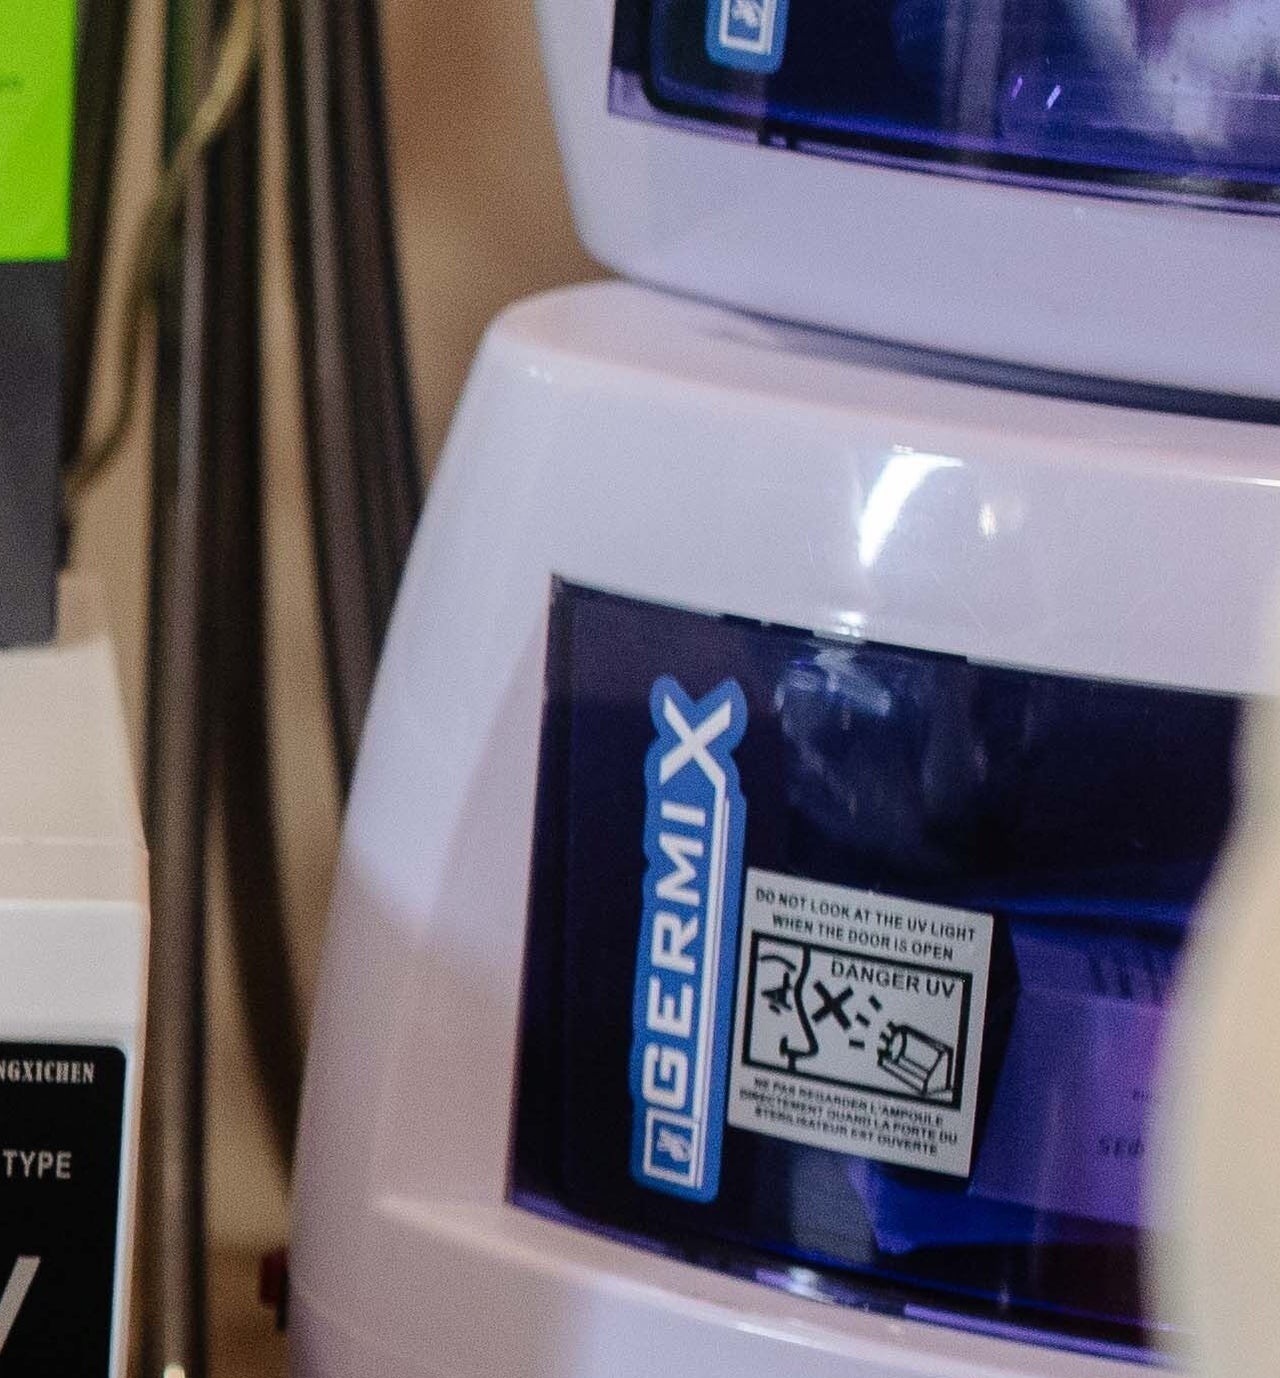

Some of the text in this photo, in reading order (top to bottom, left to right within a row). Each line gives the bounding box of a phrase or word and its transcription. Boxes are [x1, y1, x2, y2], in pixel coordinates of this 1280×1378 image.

[641, 695, 732, 1112] GERMIX
[756, 887, 976, 942] DO NOT LOOK AT THE UV LIGHT
[772, 914, 953, 961] WHEN THE DOOR IS OPEN
[831, 960, 956, 999] DANGER UV
[3, 1150, 72, 1179] TYPE
